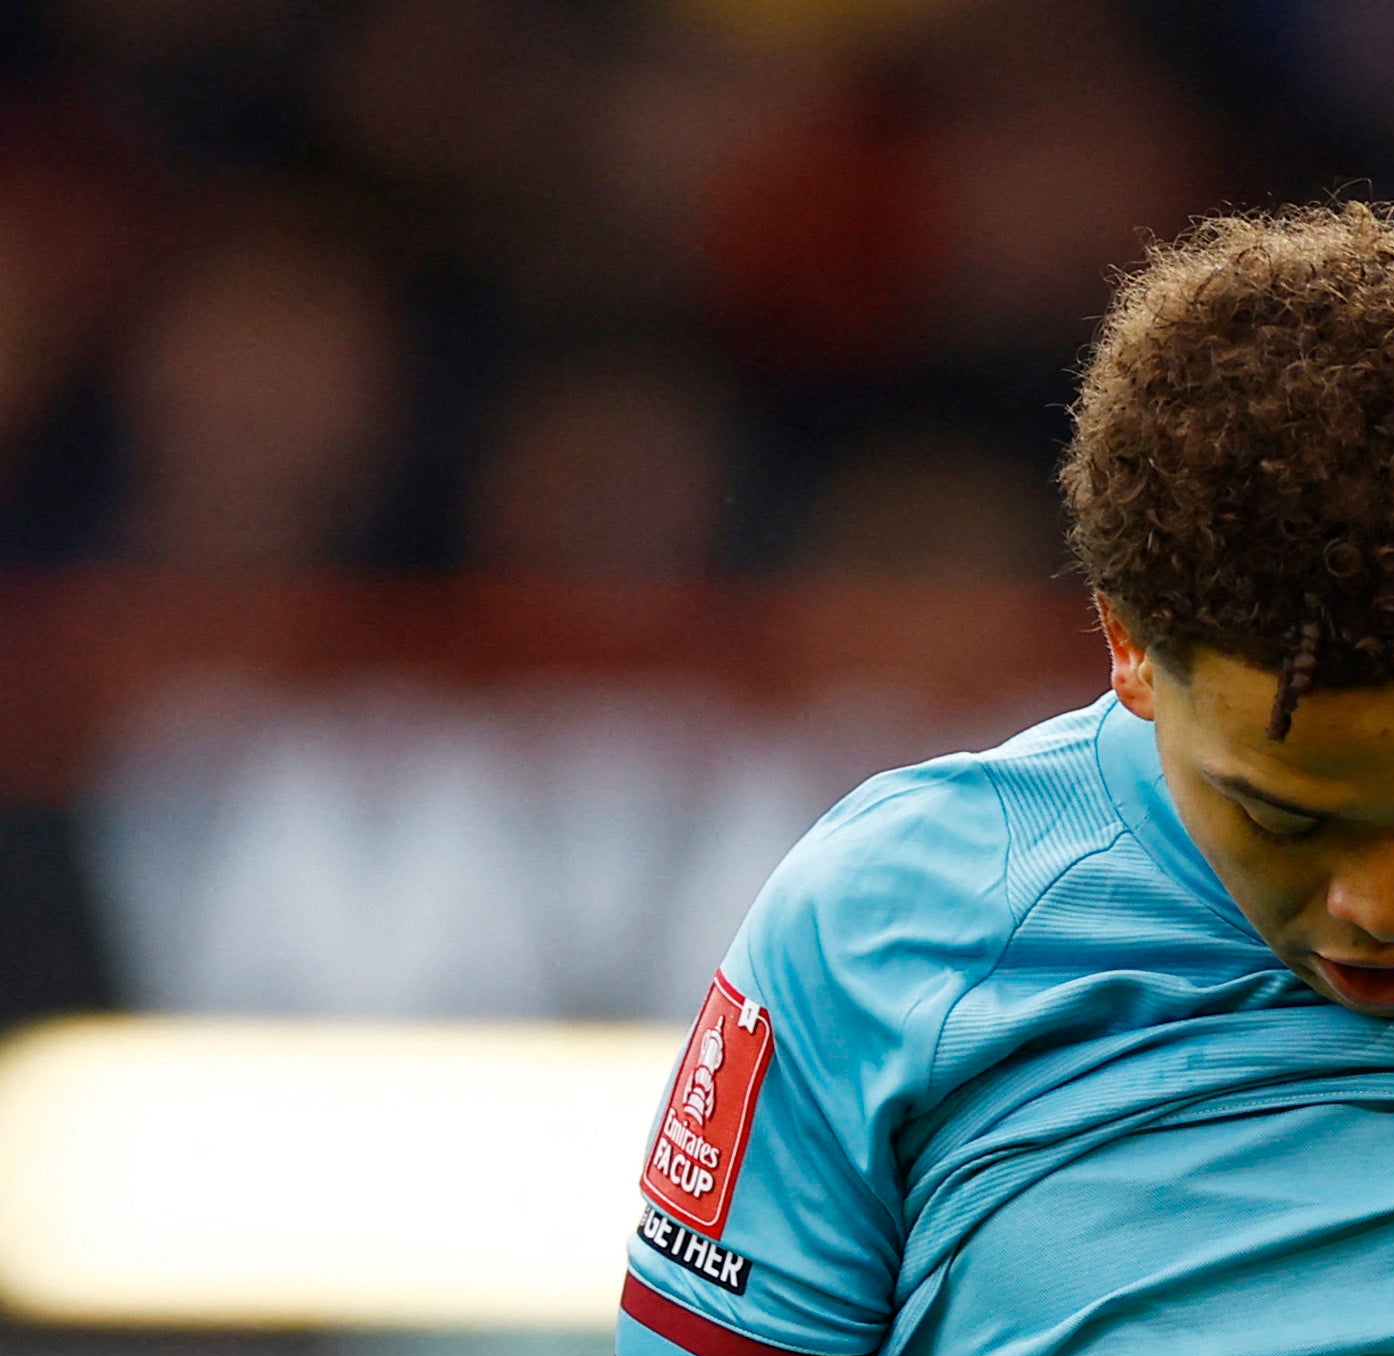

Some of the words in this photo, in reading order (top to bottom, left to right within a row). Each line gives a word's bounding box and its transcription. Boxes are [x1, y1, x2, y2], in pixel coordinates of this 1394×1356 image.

[652, 1137, 673, 1177] FA
[669, 1153, 714, 1198] CUP
[663, 1107, 720, 1169] Emirates
